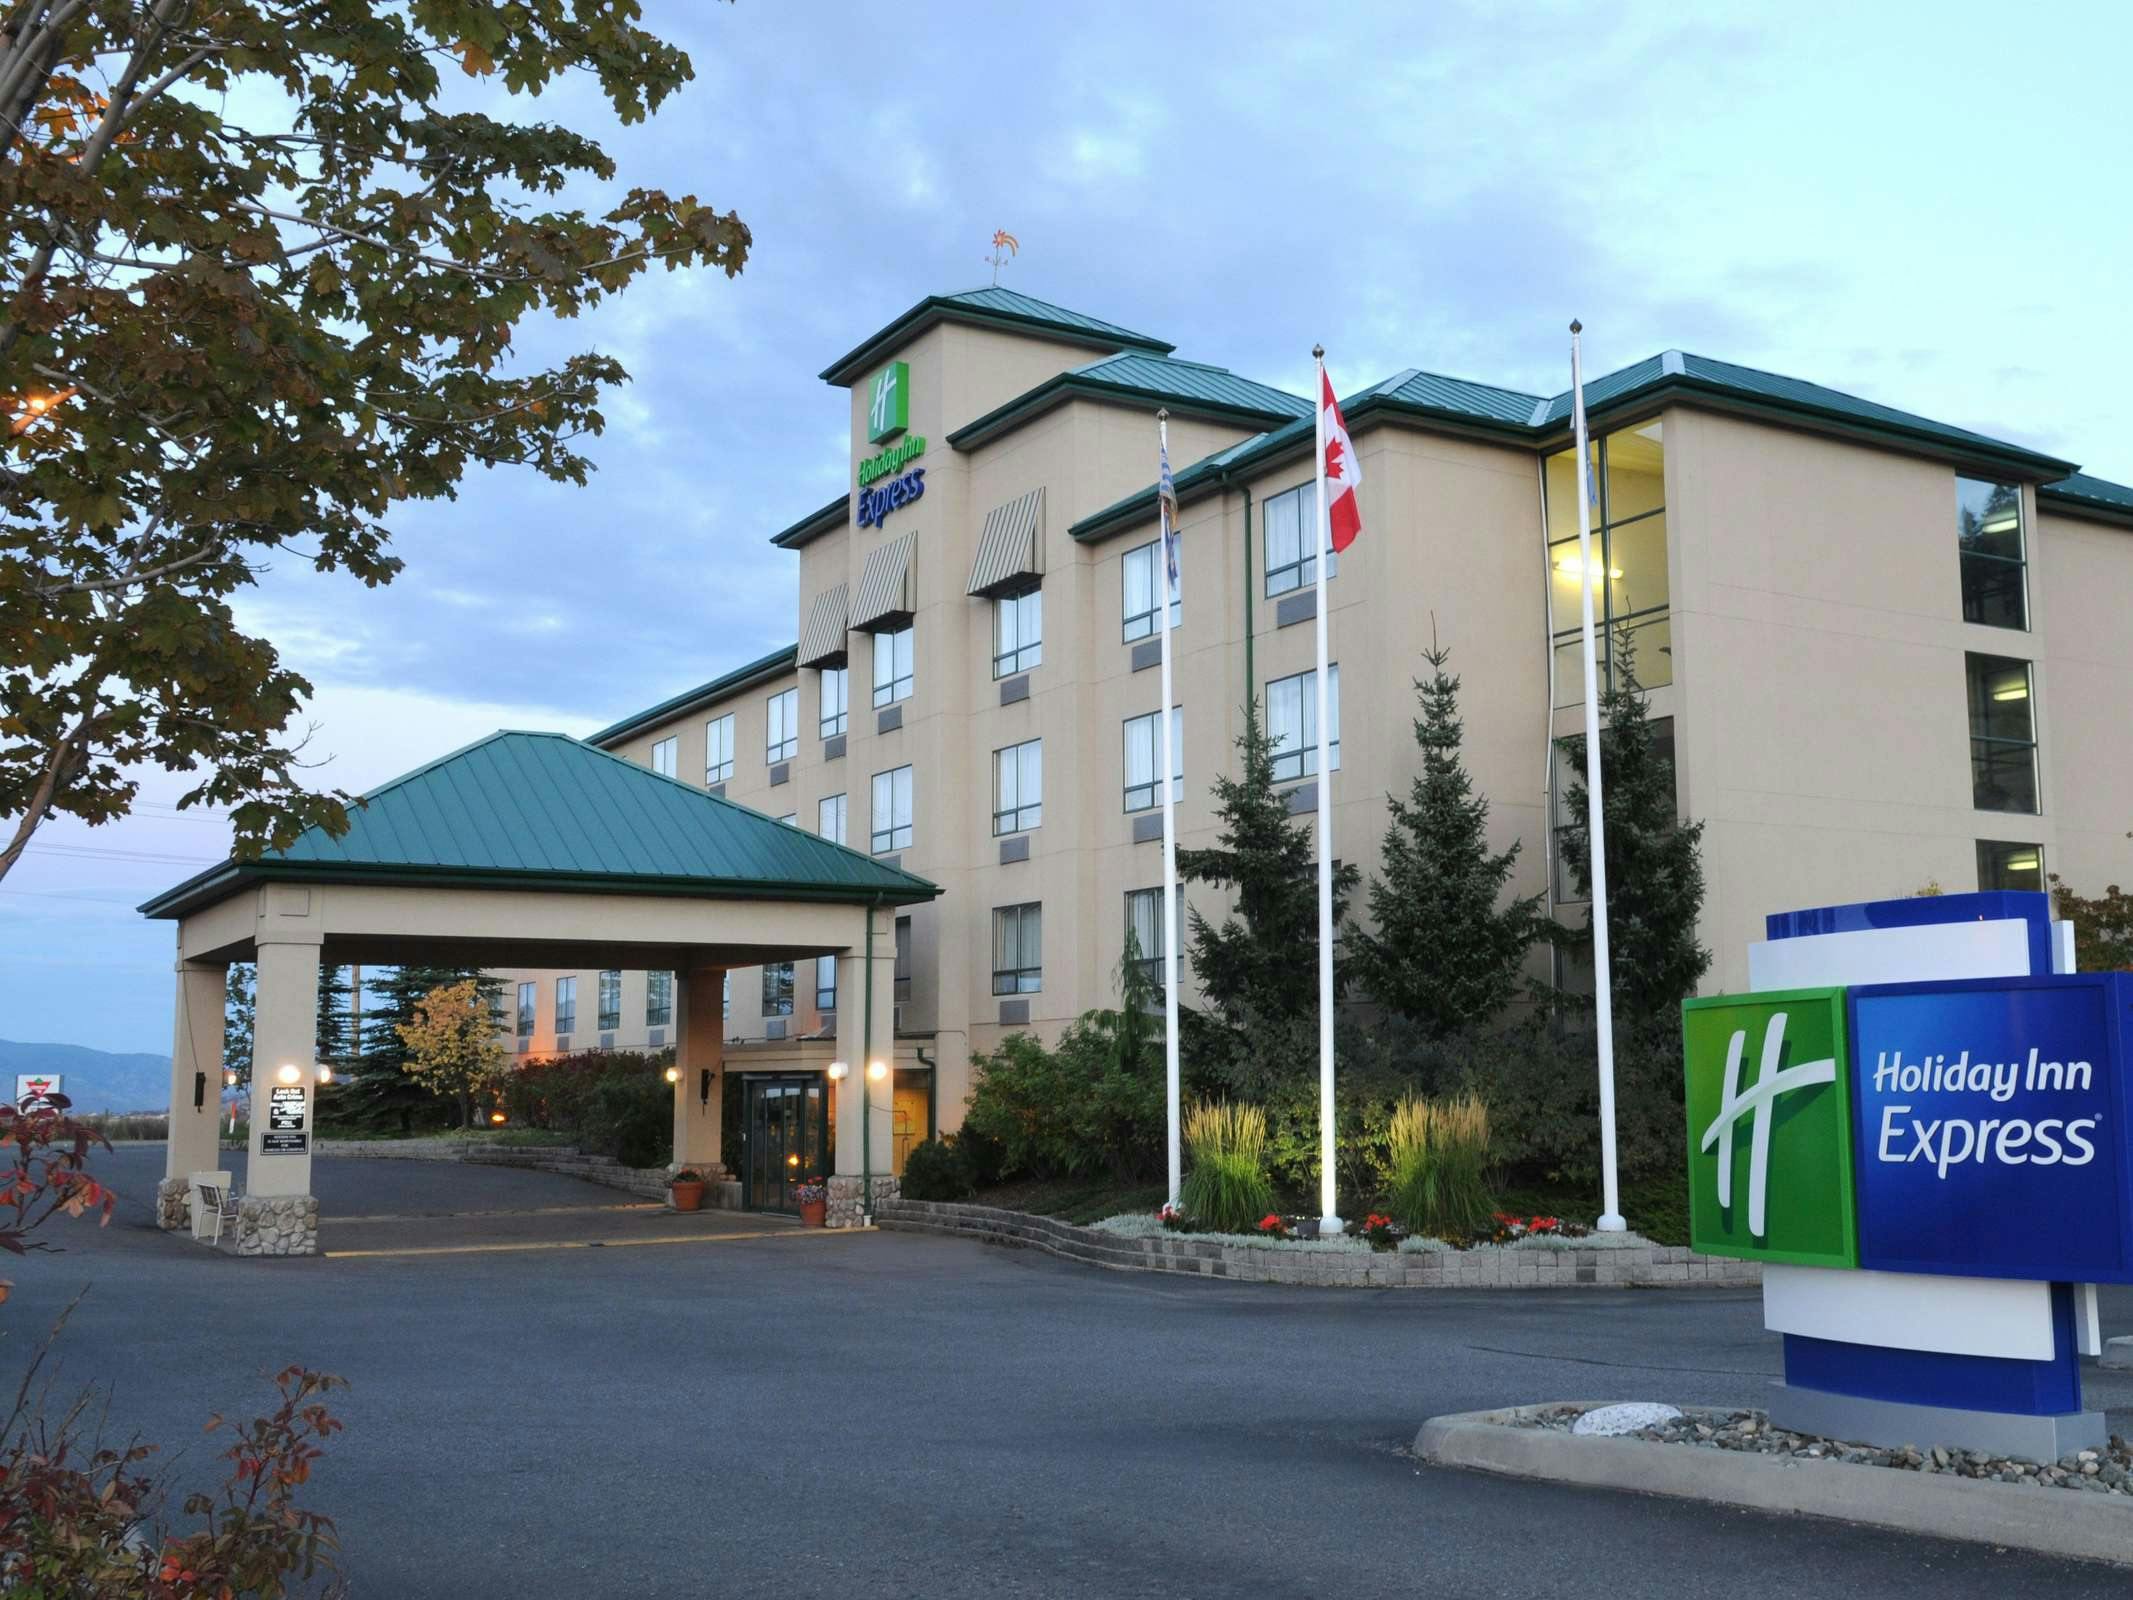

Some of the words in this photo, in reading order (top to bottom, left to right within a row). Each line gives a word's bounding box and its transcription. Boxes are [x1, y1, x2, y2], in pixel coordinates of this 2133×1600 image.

[858, 447, 904, 487] Holiday
[901, 434, 926, 462] Inn
[857, 468, 926, 528] Express
[1872, 1050, 2018, 1102] Holiday
[2025, 1047, 2092, 1091] Inn
[1878, 1105, 2096, 1180] Express
